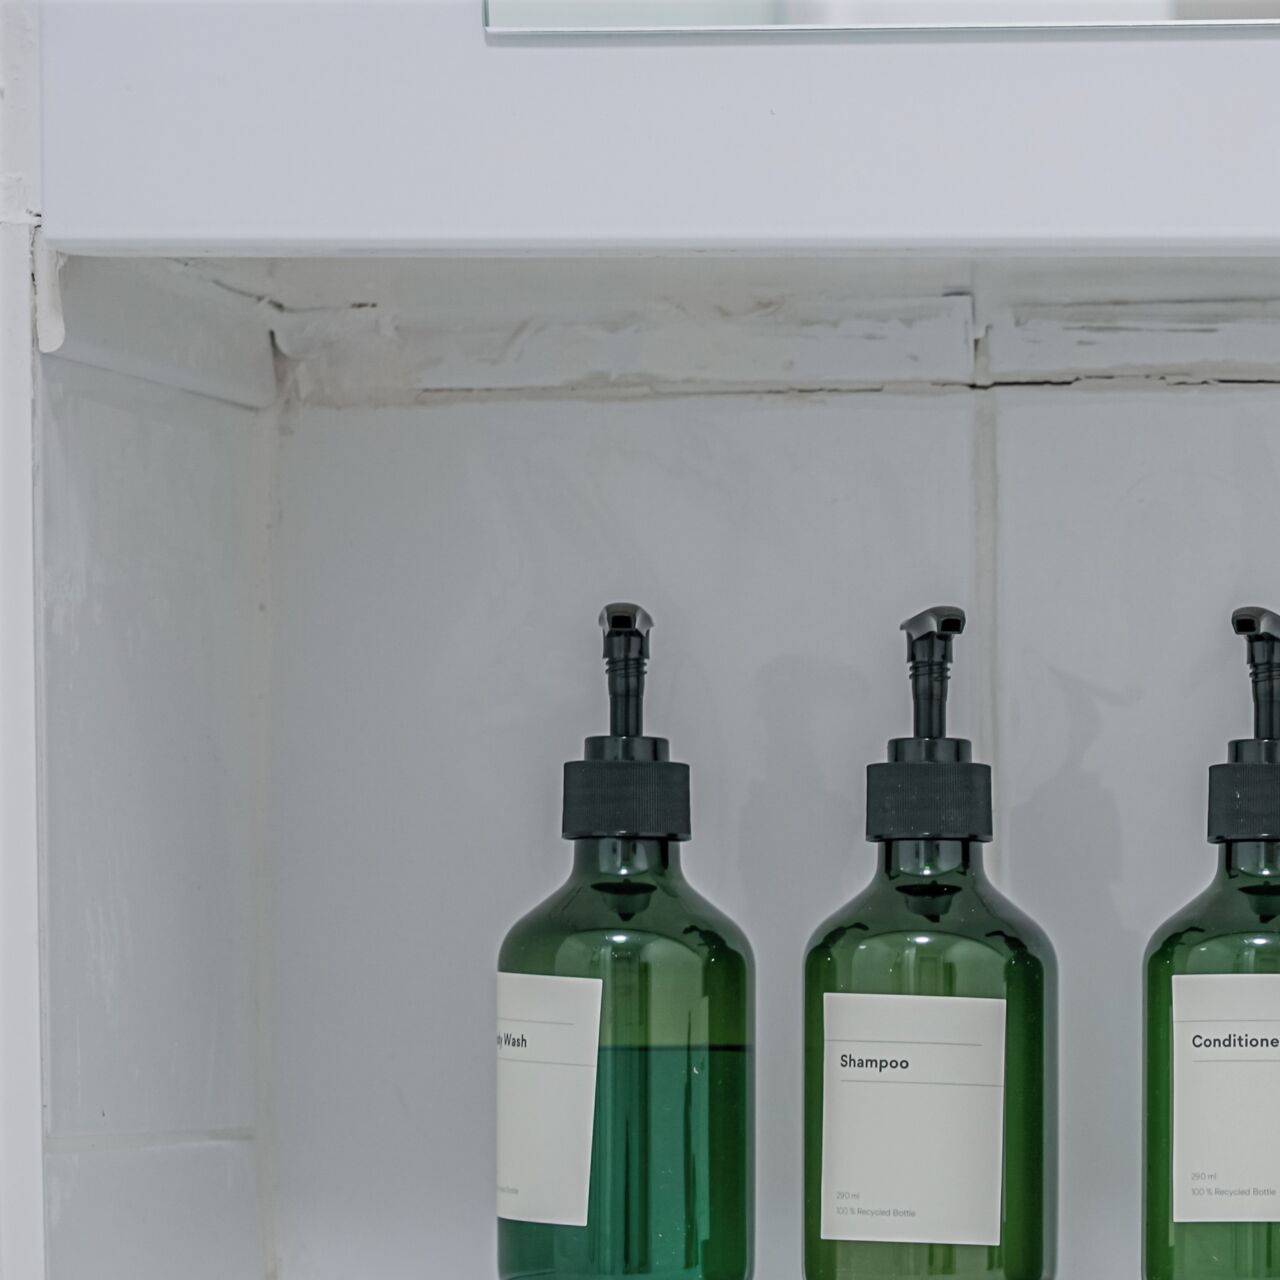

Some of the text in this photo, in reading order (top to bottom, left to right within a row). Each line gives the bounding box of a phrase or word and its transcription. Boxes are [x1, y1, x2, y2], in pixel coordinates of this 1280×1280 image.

[503, 1032, 527, 1048] Wash
[840, 1054, 910, 1072] Shampoo
[1214, 1187, 1251, 1197] Recycled
[1252, 1187, 1277, 1196] Bottle
[857, 1207, 891, 1217] Recycled
[892, 1208, 917, 1217] Bottle
